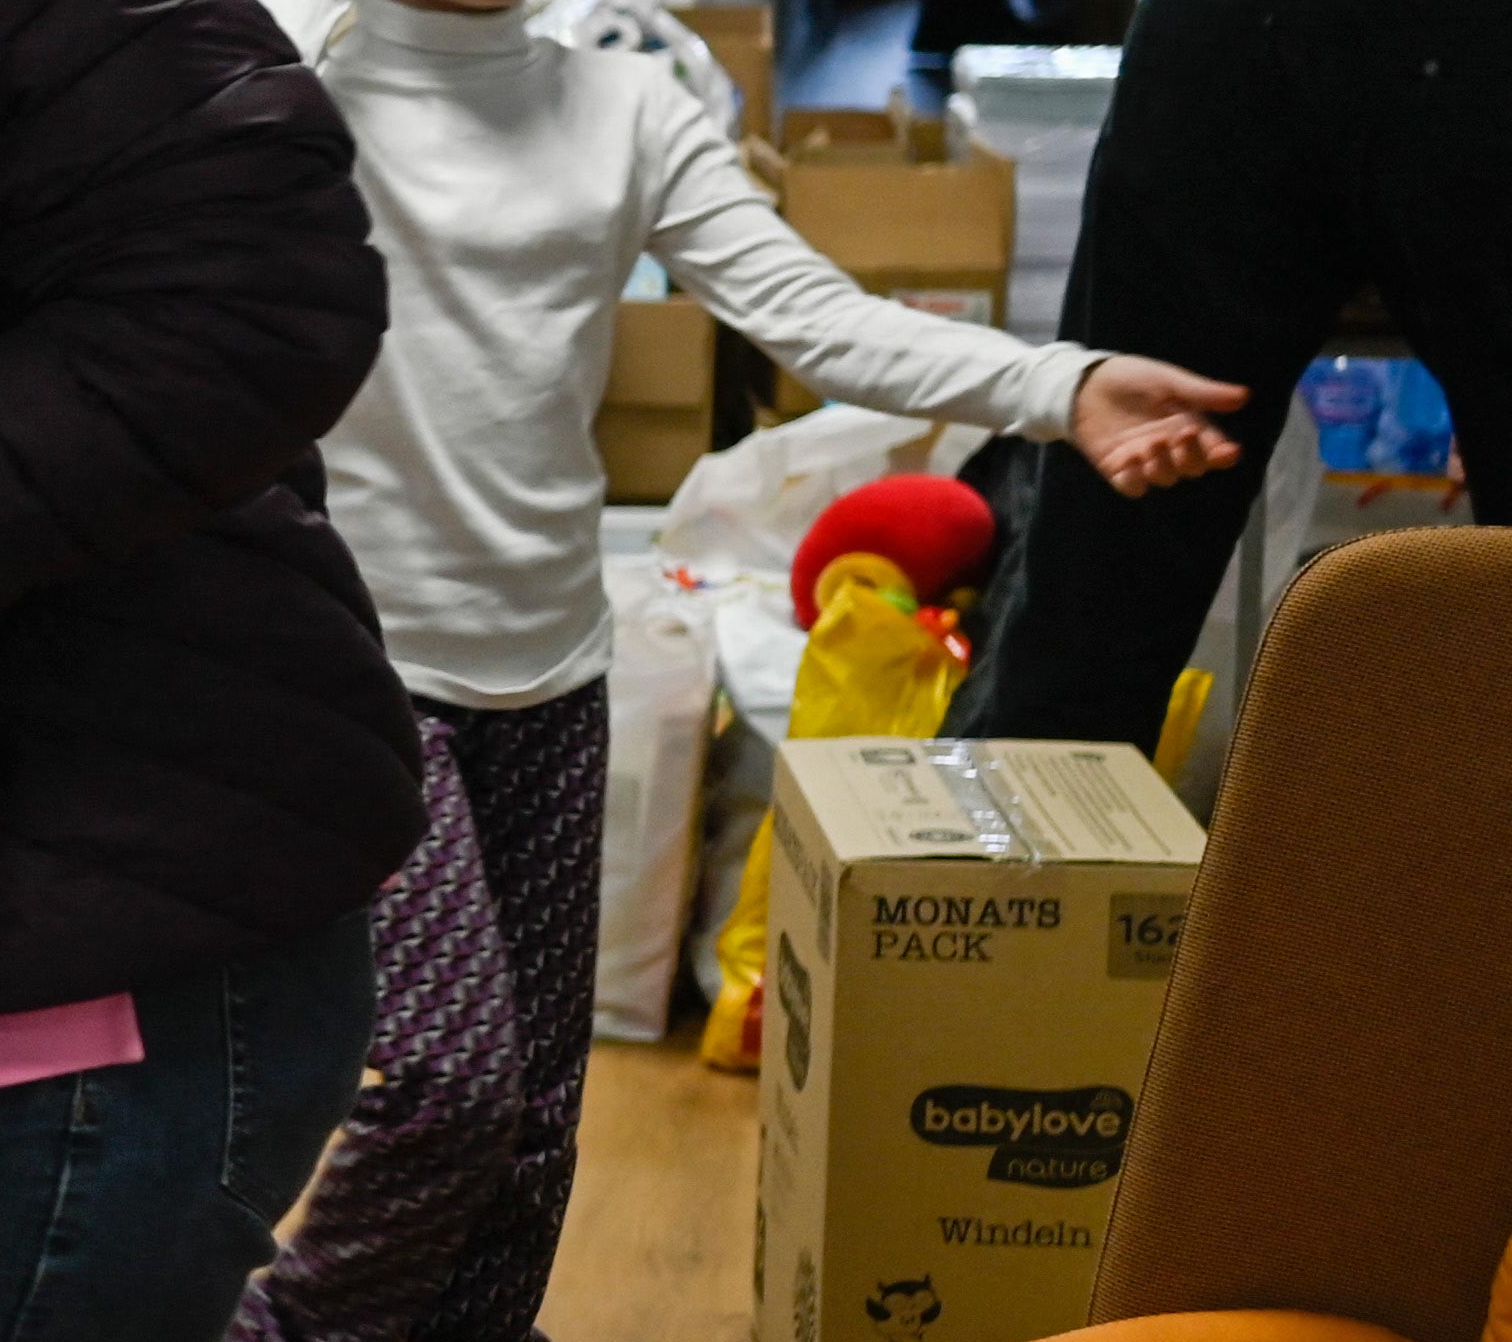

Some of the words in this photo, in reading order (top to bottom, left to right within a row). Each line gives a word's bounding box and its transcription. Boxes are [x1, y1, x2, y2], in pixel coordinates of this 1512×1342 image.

[872, 895, 1061, 929] MONATS
[872, 929, 994, 961] PACK
[924, 1099, 1120, 1142] babylove
[1007, 1159, 1108, 1180] nature
[938, 1216, 1093, 1247] Windeln
